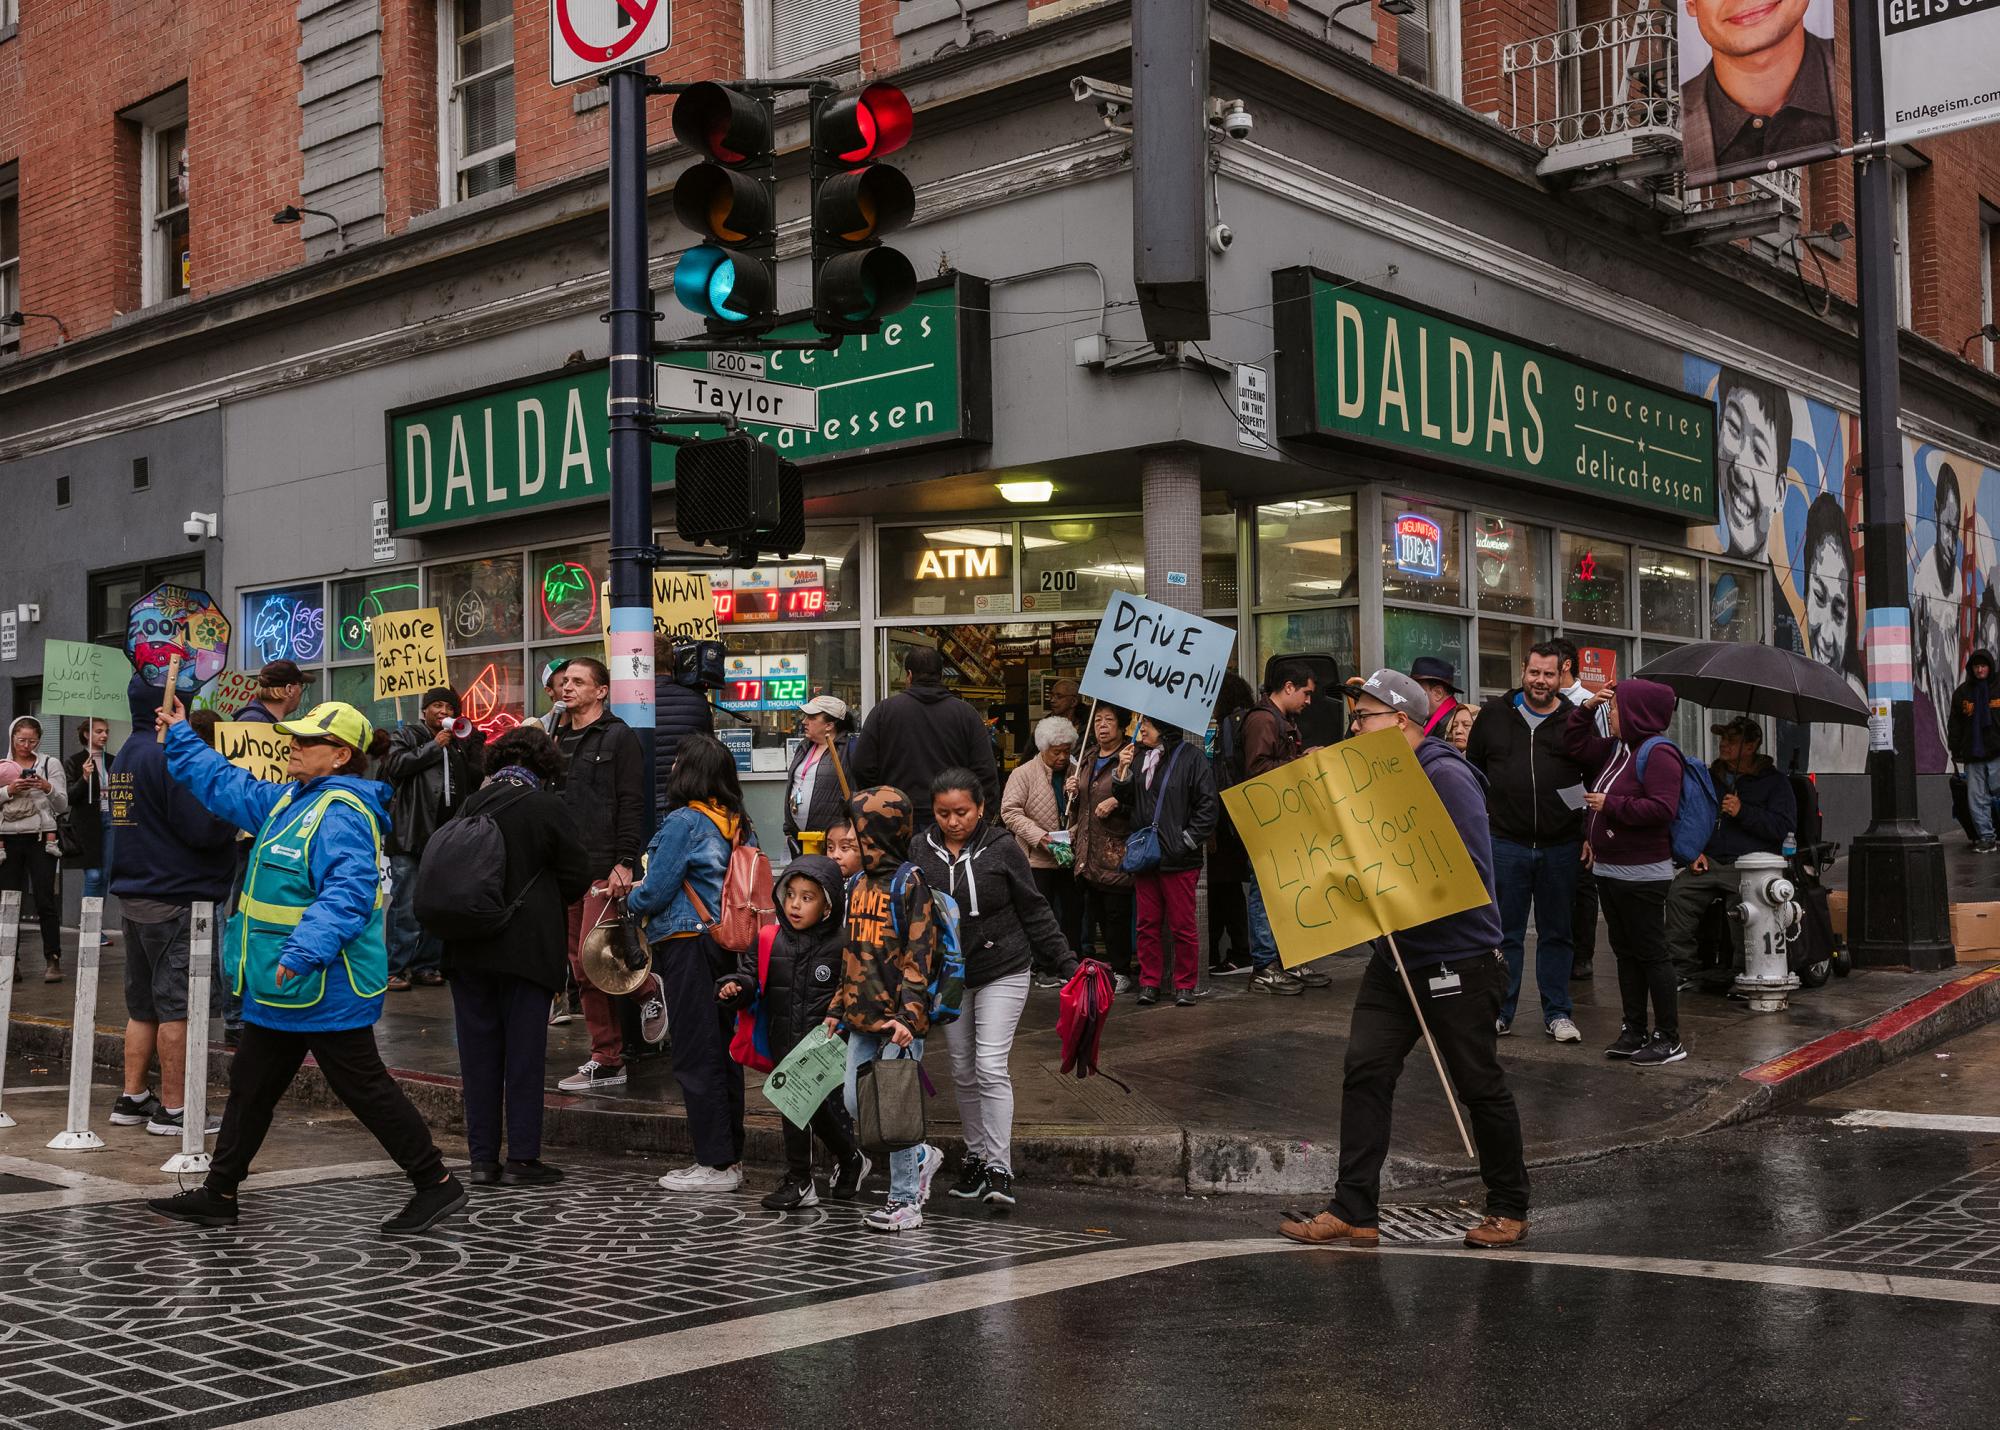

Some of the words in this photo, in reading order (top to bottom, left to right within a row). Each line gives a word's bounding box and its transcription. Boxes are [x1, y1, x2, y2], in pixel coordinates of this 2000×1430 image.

[1896, 90, 2000, 122] EndAgeism.com
[717, 352, 746, 372] 200
[1249, 376, 1256, 387] NO
[1336, 300, 1545, 465] DALDAS
[693, 379, 783, 415] Taylor
[1239, 387, 1266, 403] LOITERING
[1242, 401, 1250, 411] ON
[1251, 403, 1263, 415] THIS
[1575, 384, 1702, 440] groceries
[1240, 414, 1266, 429] PROPERTY
[406, 386, 611, 517] DALDA
[1576, 443, 1702, 504] delicatessen
[1398, 521, 1438, 541] LAGUNITAS
[1476, 532, 1510, 551] udweiser
[1402, 534, 1435, 567] IPA
[916, 548, 997, 580] ATM
[655, 574, 706, 604] WANT
[1042, 571, 1076, 591] 200
[766, 593, 777, 611] 7
[790, 591, 823, 611] 178
[743, 612, 770, 620] MILLION
[788, 611, 816, 619] MILLION
[129, 619, 191, 641] ZOOM
[67, 644, 103, 667] We
[737, 682, 760, 700] 77
[769, 680, 806, 699] 722
[221, 730, 291, 762] Whose
[1243, 771, 1347, 827] Don't
[1341, 747, 1403, 793] Drive
[1351, 801, 1417, 848] Your
[851, 890, 891, 917] GAME
[848, 918, 886, 945] TIME
[1763, 932, 1786, 954] 12
